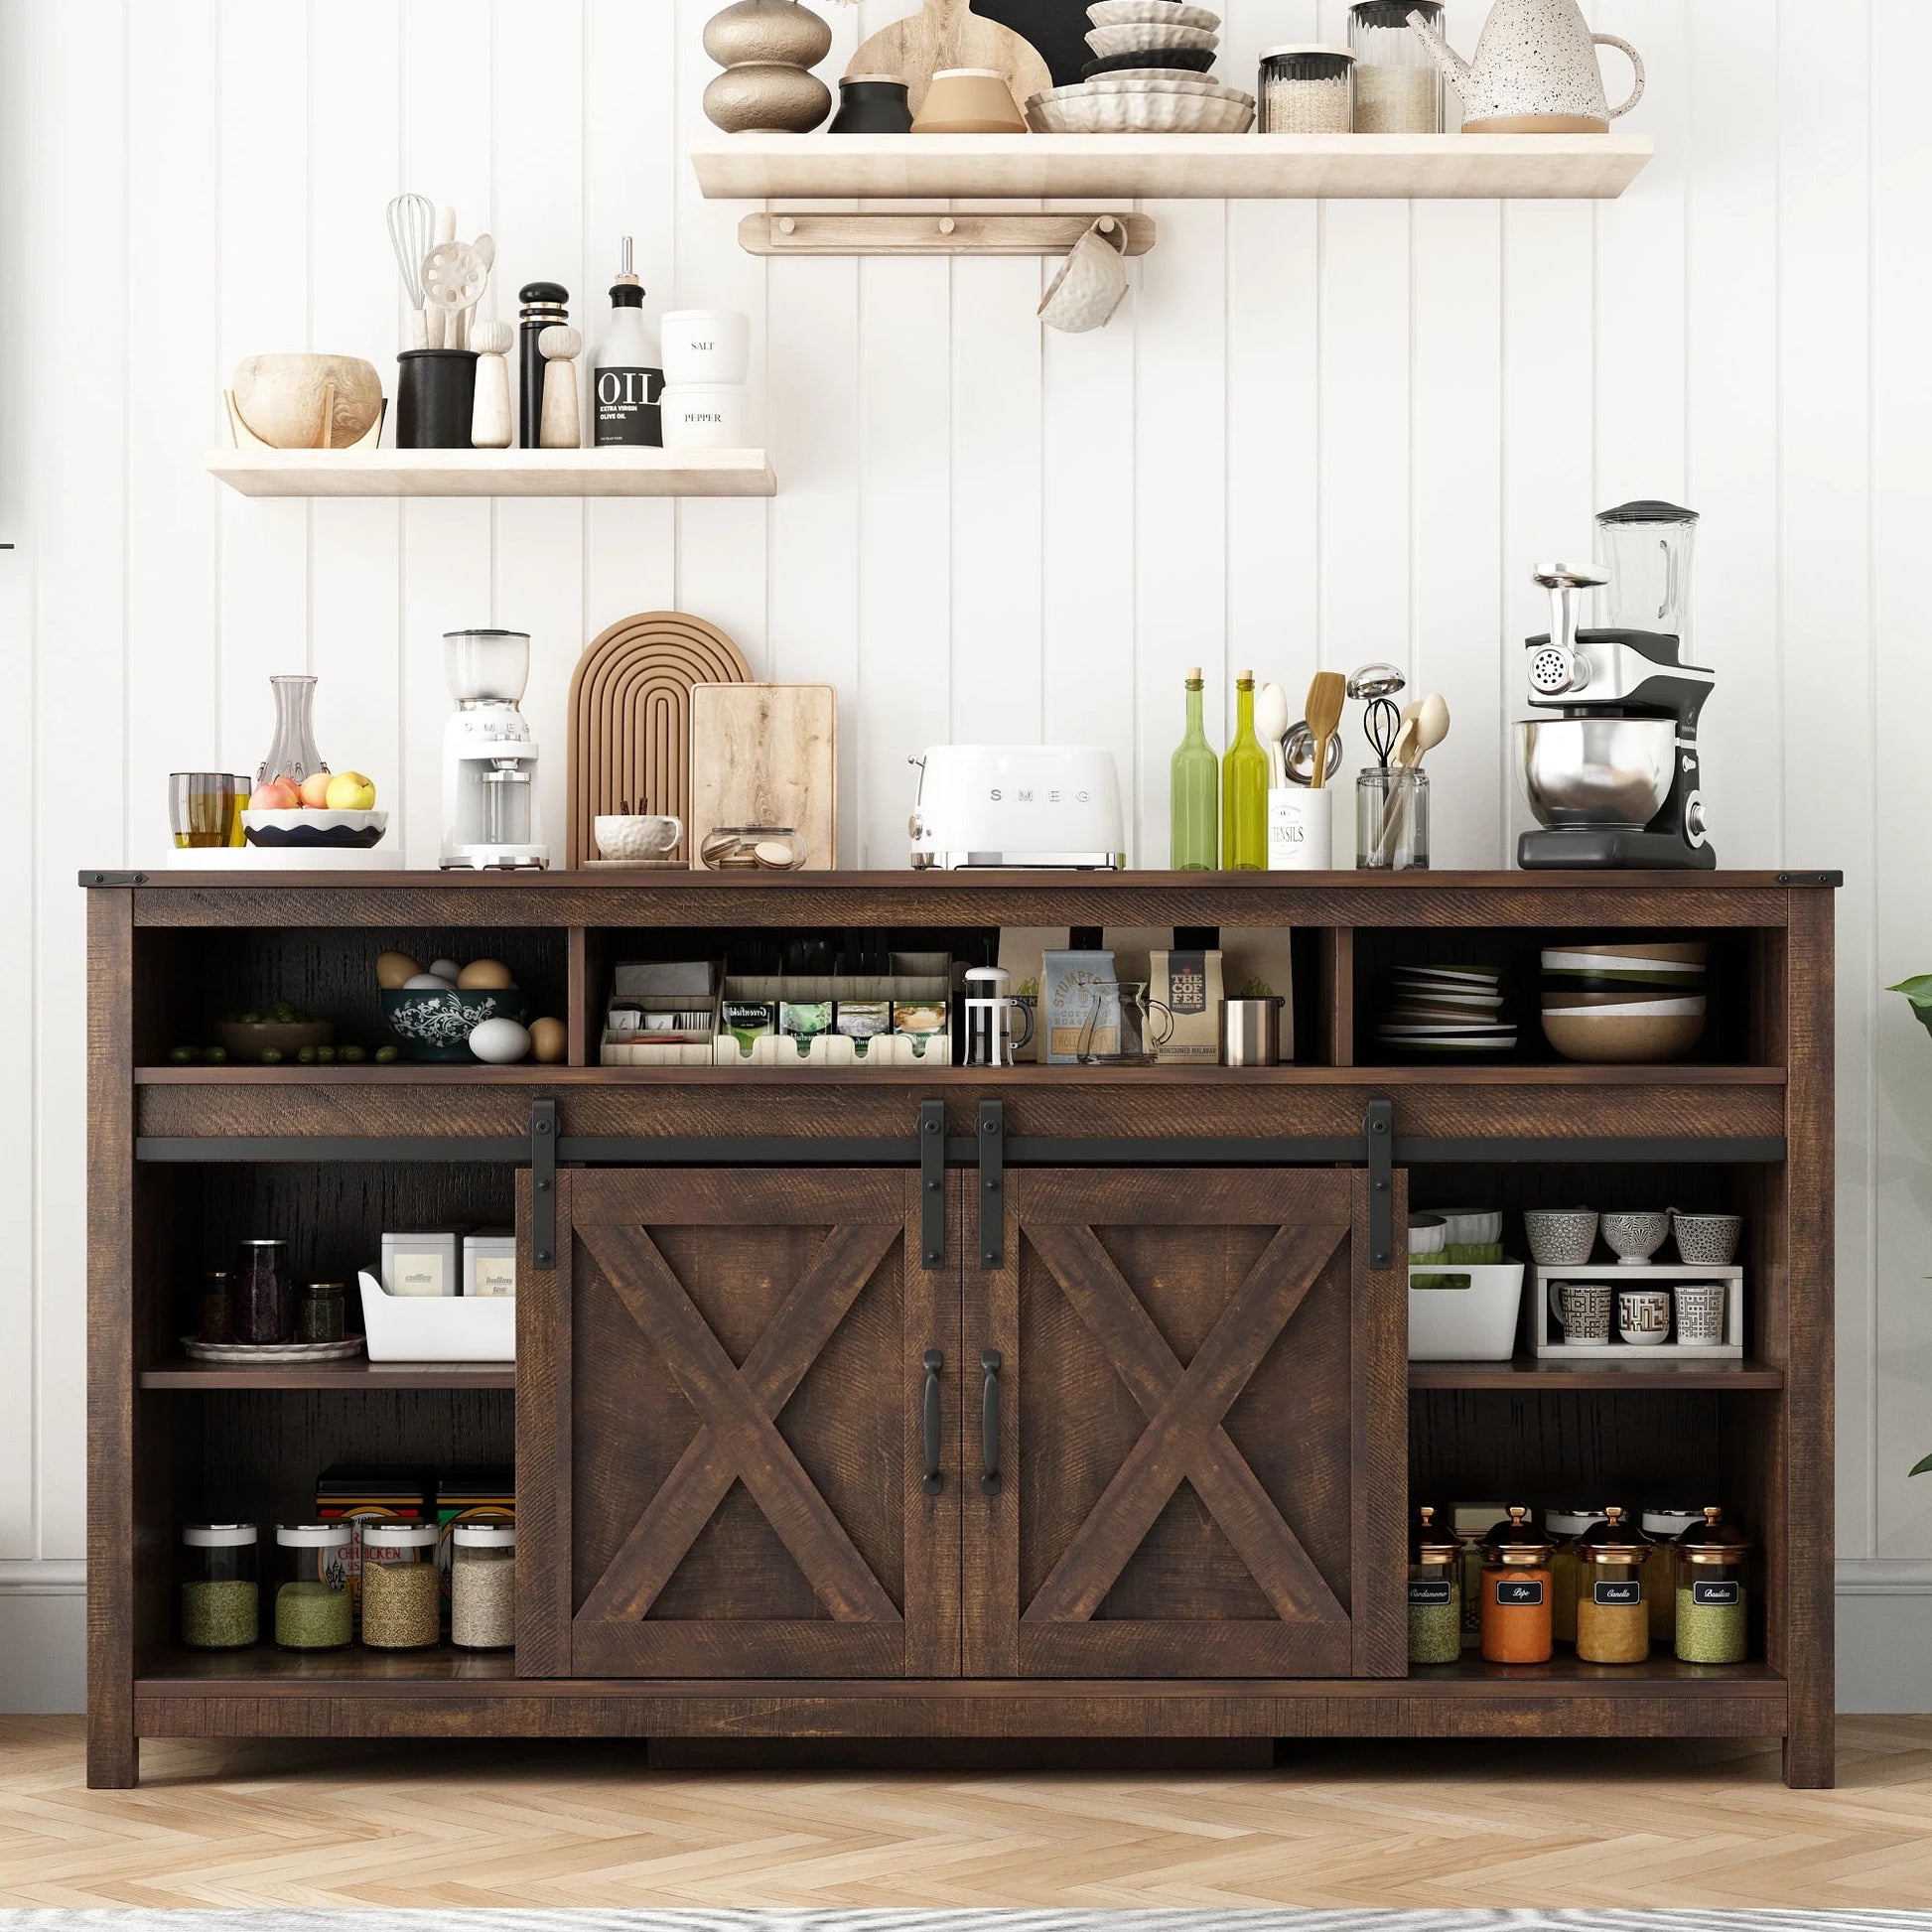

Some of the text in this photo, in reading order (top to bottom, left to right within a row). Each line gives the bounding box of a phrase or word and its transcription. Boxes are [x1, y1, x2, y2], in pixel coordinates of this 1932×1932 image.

[691, 342, 714, 350] SALT
[598, 372, 661, 405] OIL
[684, 414, 722, 423] PEPPER
[465, 723, 530, 734] SMEG
[990, 788, 1090, 802] SMEG
[1172, 974, 1202, 984] THE
[1172, 983, 1202, 993] COF
[1172, 993, 1202, 1004] FEE
